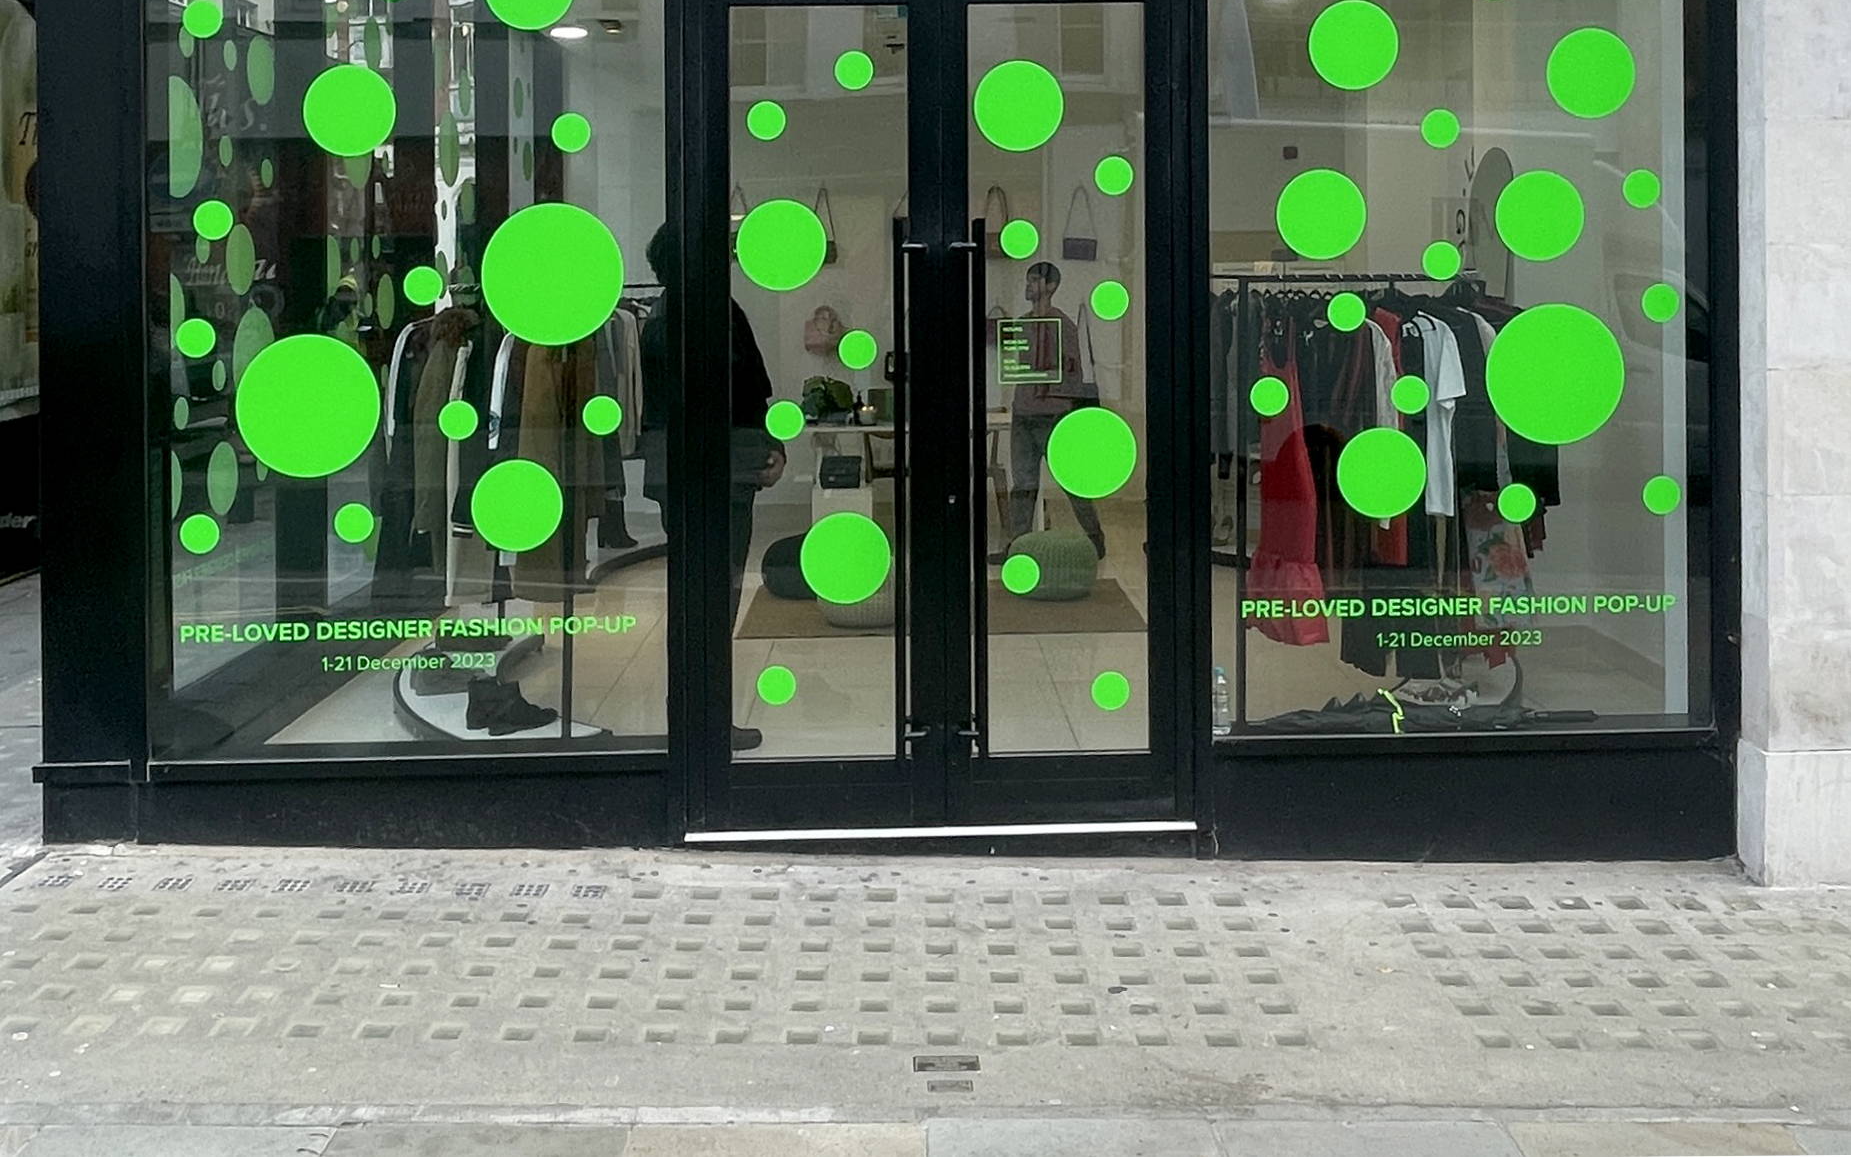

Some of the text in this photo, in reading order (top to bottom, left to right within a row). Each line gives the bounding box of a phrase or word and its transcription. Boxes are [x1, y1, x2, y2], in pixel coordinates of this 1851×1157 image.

[1241, 593, 1677, 619] PRE-LOVED DESIGNER FASHION POP-UP
[179, 615, 636, 643] PRE-LOVED DESIGNER FASHION POP-UP
[1376, 629, 1543, 648] 1-21 December 2023
[321, 651, 496, 672] 1-21 December 2023
